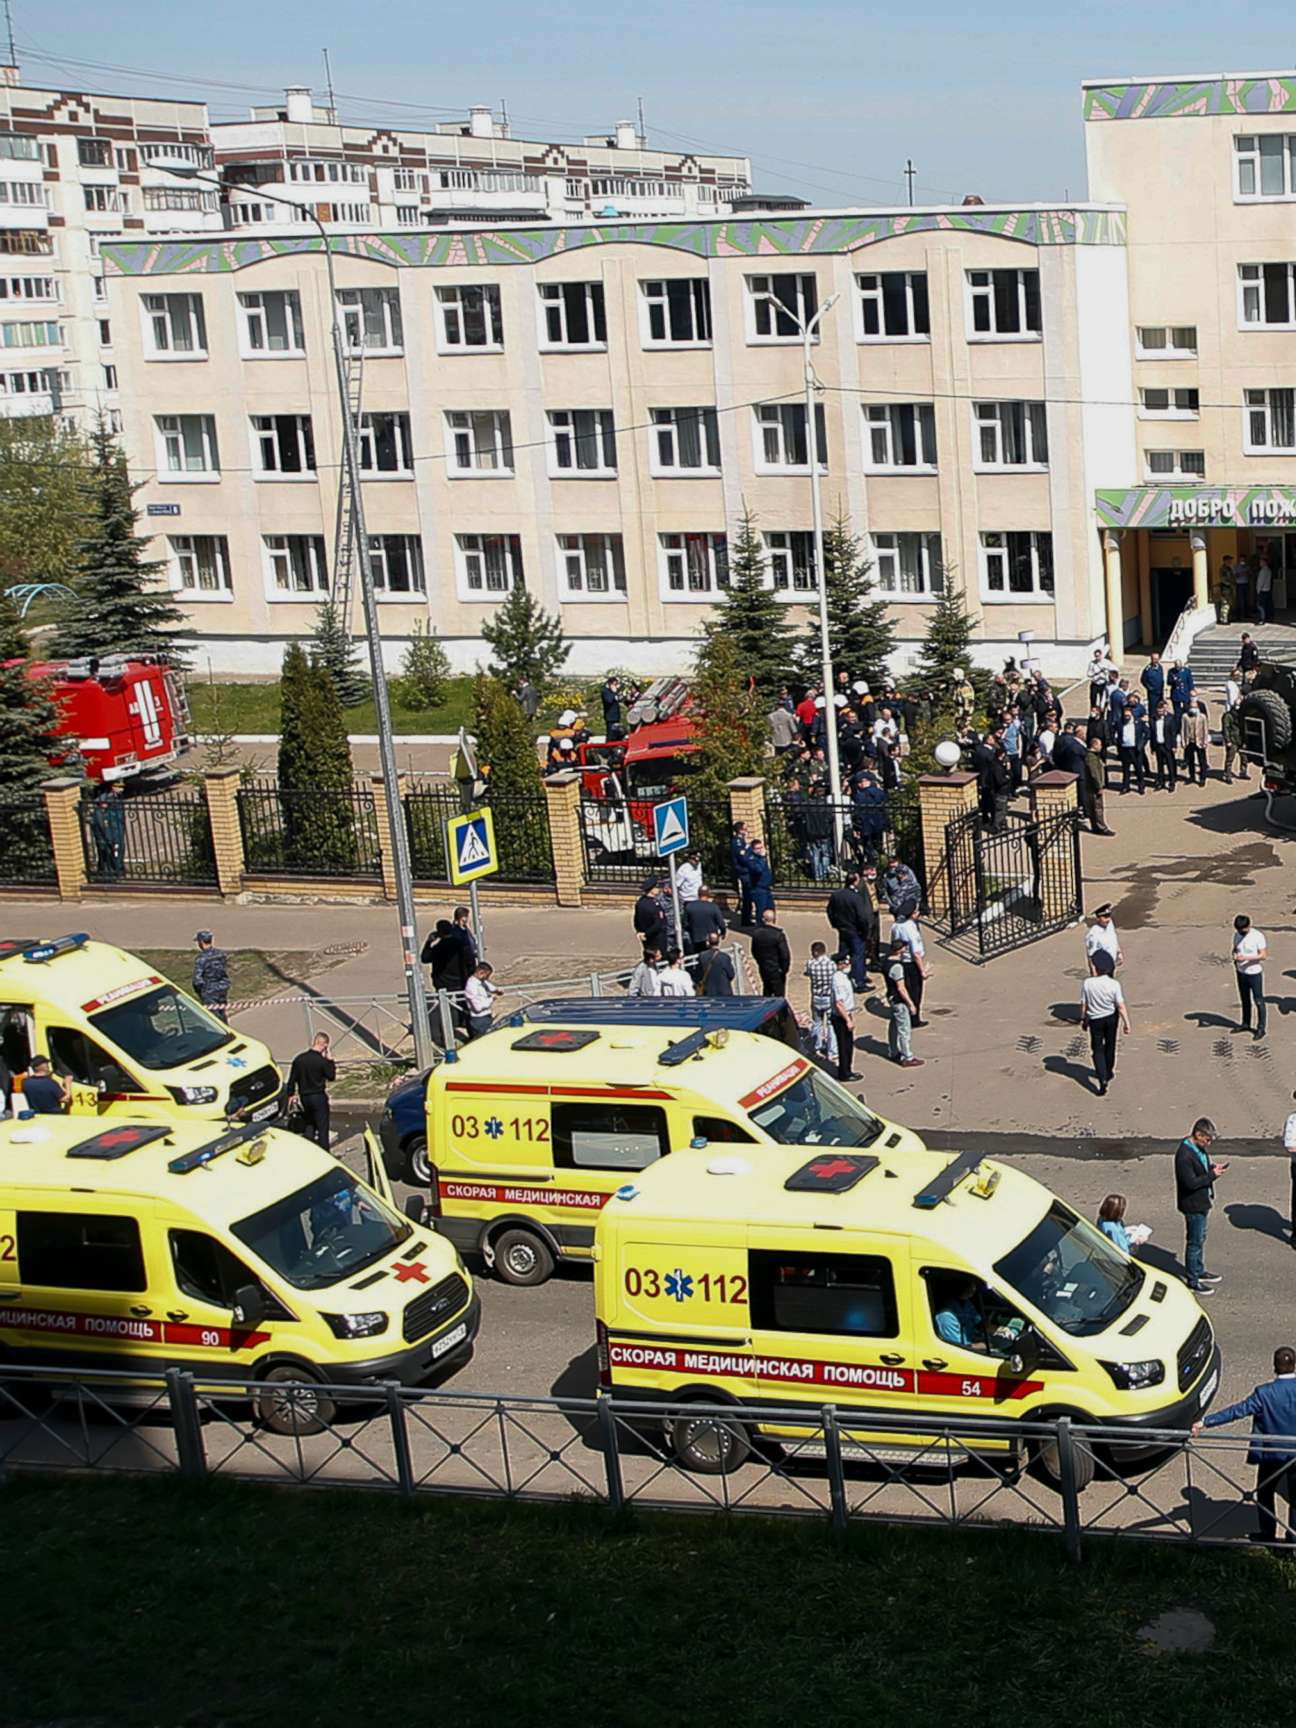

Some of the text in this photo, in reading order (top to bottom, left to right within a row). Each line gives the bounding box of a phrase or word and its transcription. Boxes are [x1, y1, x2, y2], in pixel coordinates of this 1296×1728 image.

[1169, 498, 1235, 523] ДОБРО
[452, 1115, 550, 1142] 03 112
[447, 1185, 600, 1206] СКОРАЯ МЕДИЦИНСКАЯ
[625, 1267, 748, 1305] 03 112
[85, 1317, 154, 1338] ПОМОЩЬ
[201, 1331, 219, 1346] 90
[610, 1347, 905, 1389] СКОРАЯ МЕДИЦИНСКАЯ ПОМОЩЬ
[961, 1380, 982, 1396] 54
